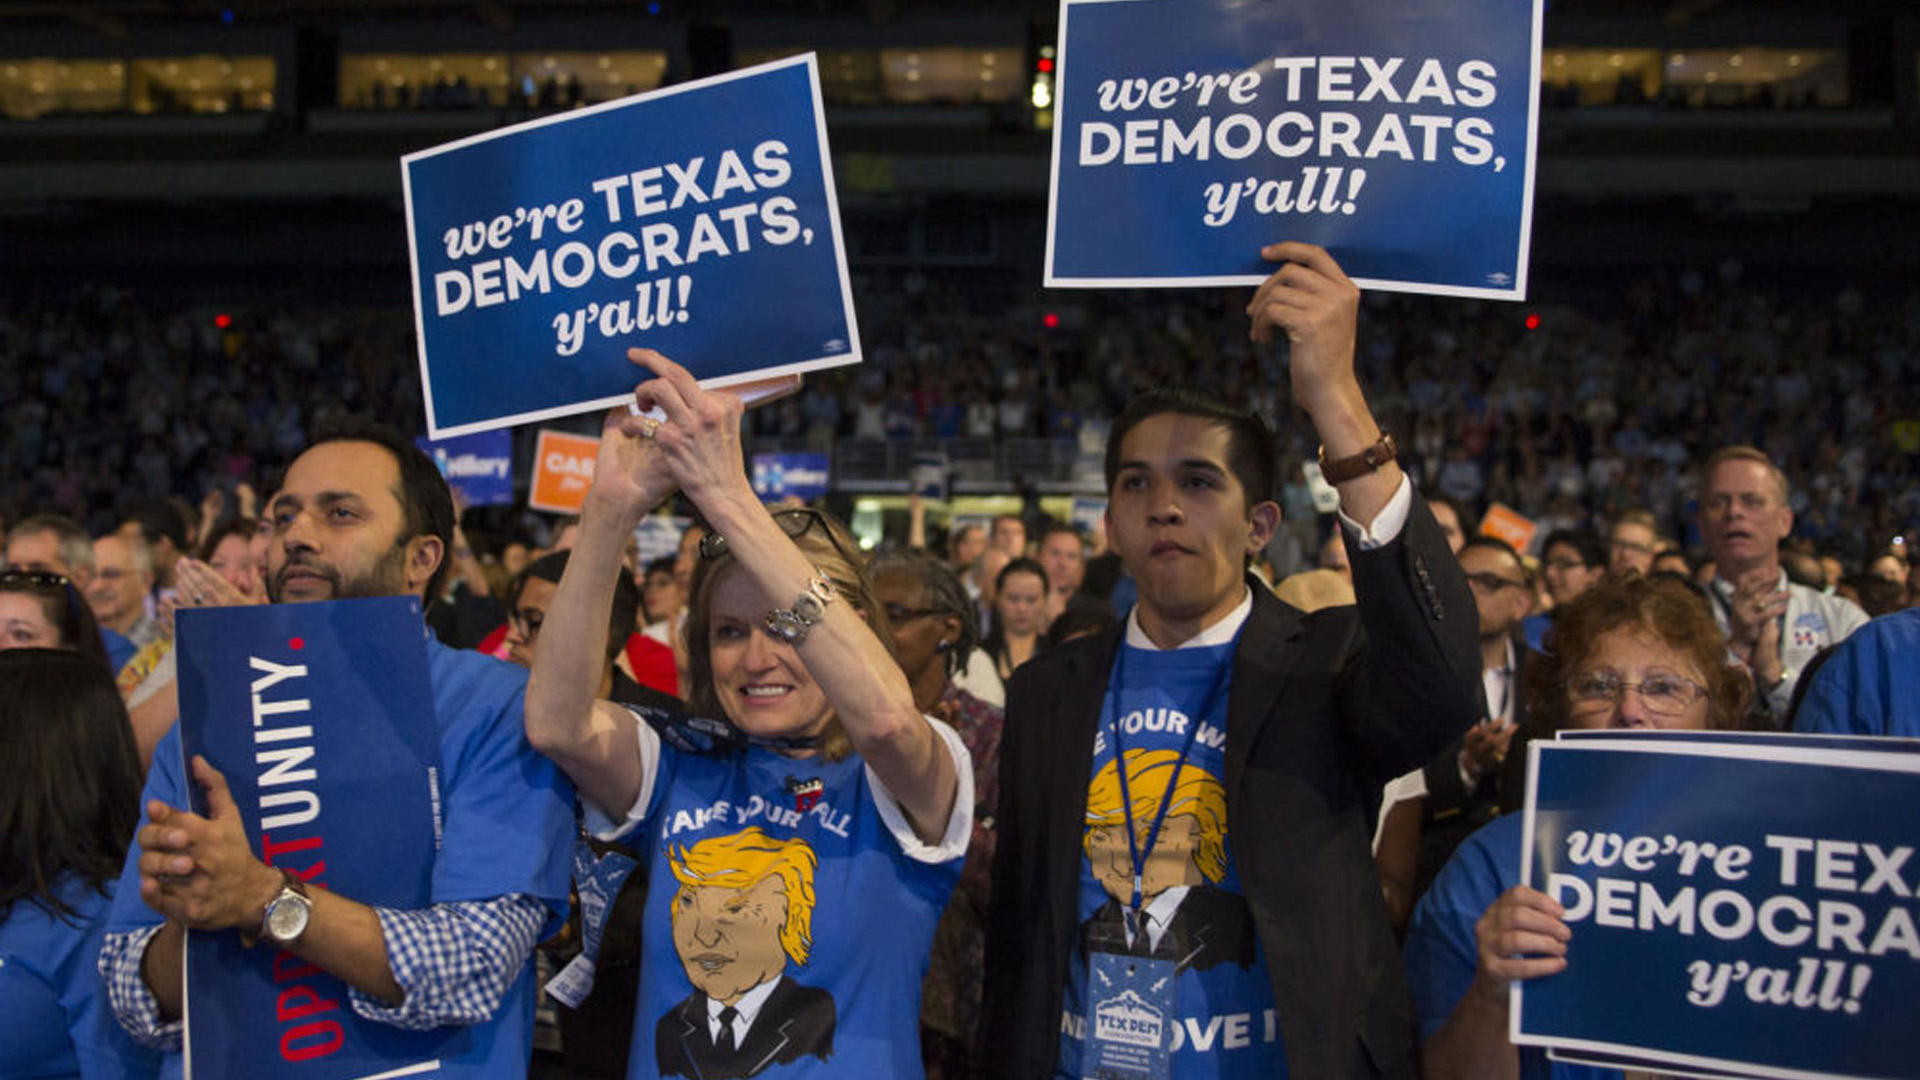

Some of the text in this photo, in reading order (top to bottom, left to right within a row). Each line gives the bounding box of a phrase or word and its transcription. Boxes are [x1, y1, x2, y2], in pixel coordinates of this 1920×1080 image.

[1097, 57, 1498, 113] we're TEXAS
[1079, 112, 1507, 173] DEMOCRATS,
[443, 140, 792, 260] we're TEXAS
[1202, 166, 1367, 228] y'all!
[434, 196, 814, 317] DEMOCRATS,
[552, 275, 693, 356] y'all!
[1195, 721, 1226, 752] W
[735, 795, 802, 828] YOUR
[1566, 830, 1920, 898] we're TEX
[1686, 957, 1873, 1015] y'all!
[1098, 1013, 1160, 1036] TEX DEM
